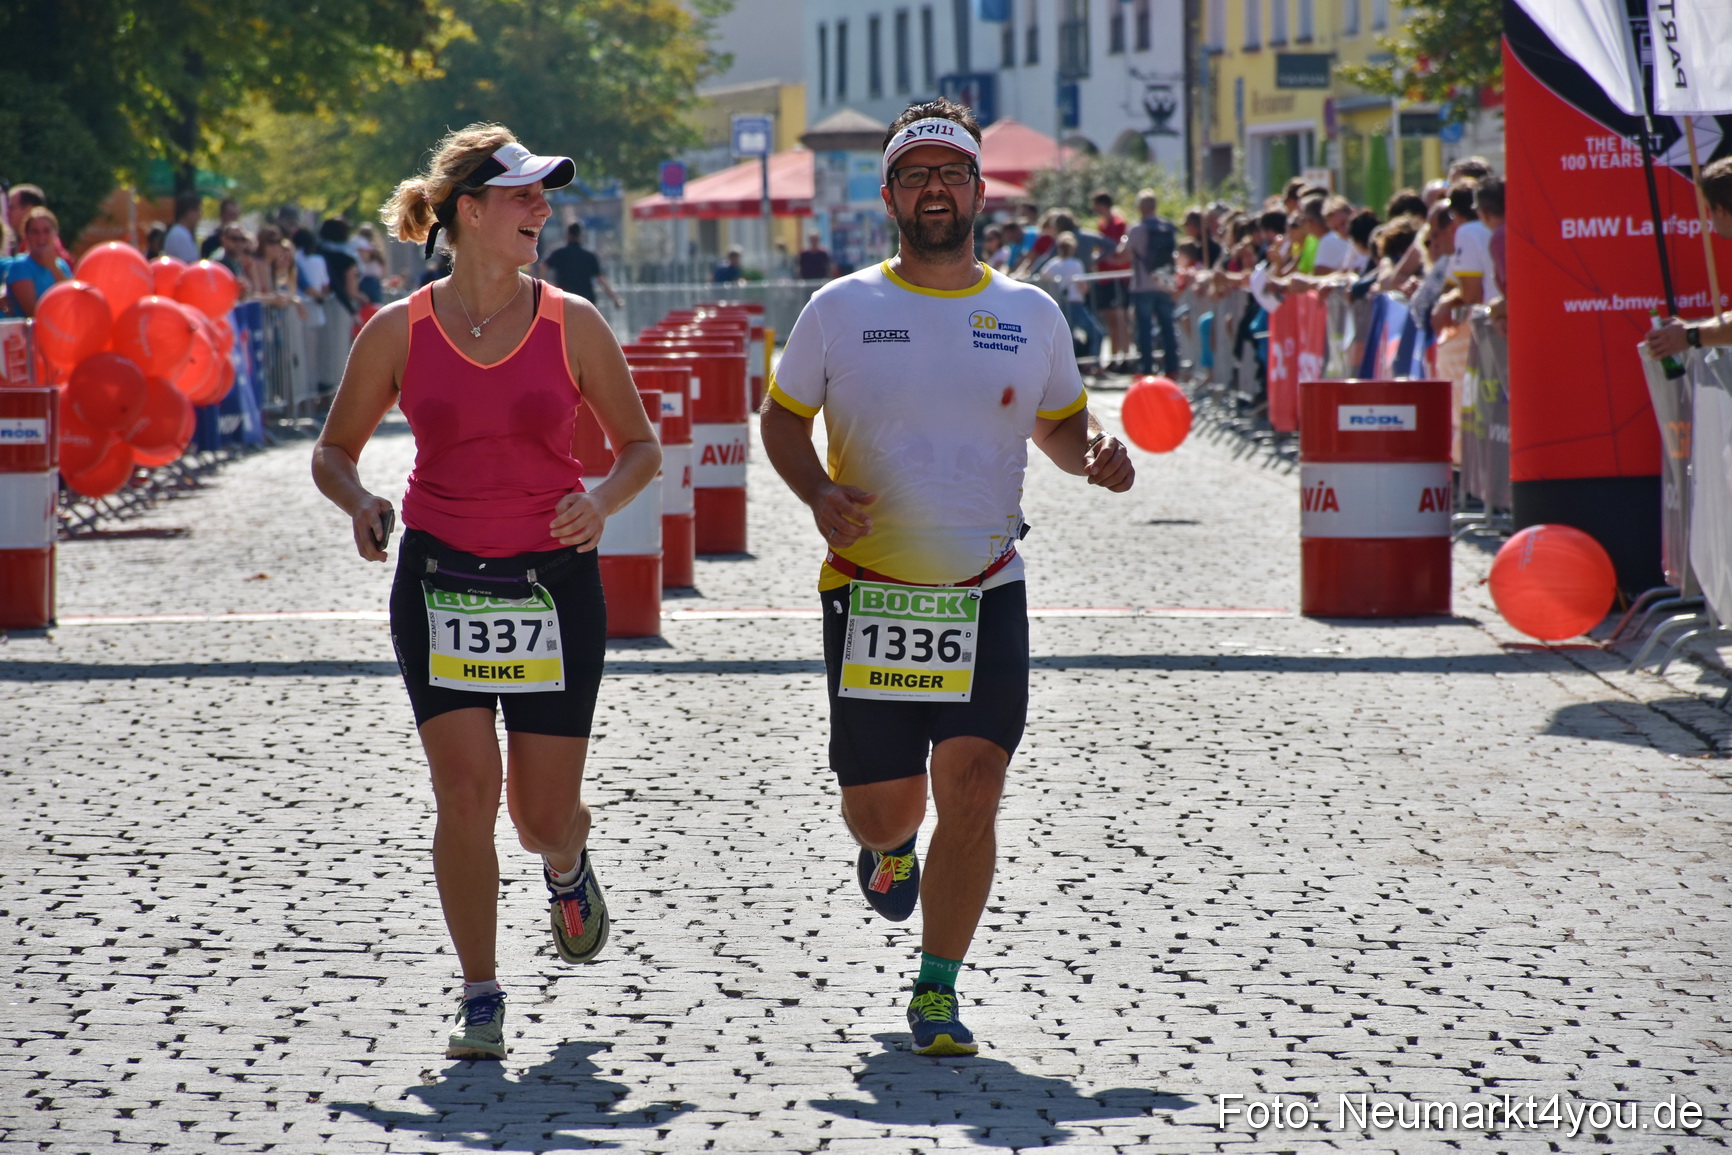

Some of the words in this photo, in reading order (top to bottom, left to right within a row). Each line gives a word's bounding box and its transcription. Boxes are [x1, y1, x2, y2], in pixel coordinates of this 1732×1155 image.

[1585, 135, 1617, 152] THE
[1560, 154, 1586, 171] 100
[1588, 152, 1644, 169] YEARS
[1561, 216, 1620, 239] BMW
[1564, 291, 1729, 313] www.bmw-artl.e
[972, 315, 997, 330] 20
[1000, 323, 1020, 332] JAHRE
[863, 330, 910, 340] BOCK
[972, 330, 1028, 344] Neumarkter
[973, 340, 1019, 354] Stadtlauf
[861, 588, 963, 617] BOCK
[445, 618, 542, 654] 1337
[861, 624, 962, 663] 1336
[463, 663, 526, 679] HEIKE
[869, 671, 944, 689] BIRGER
